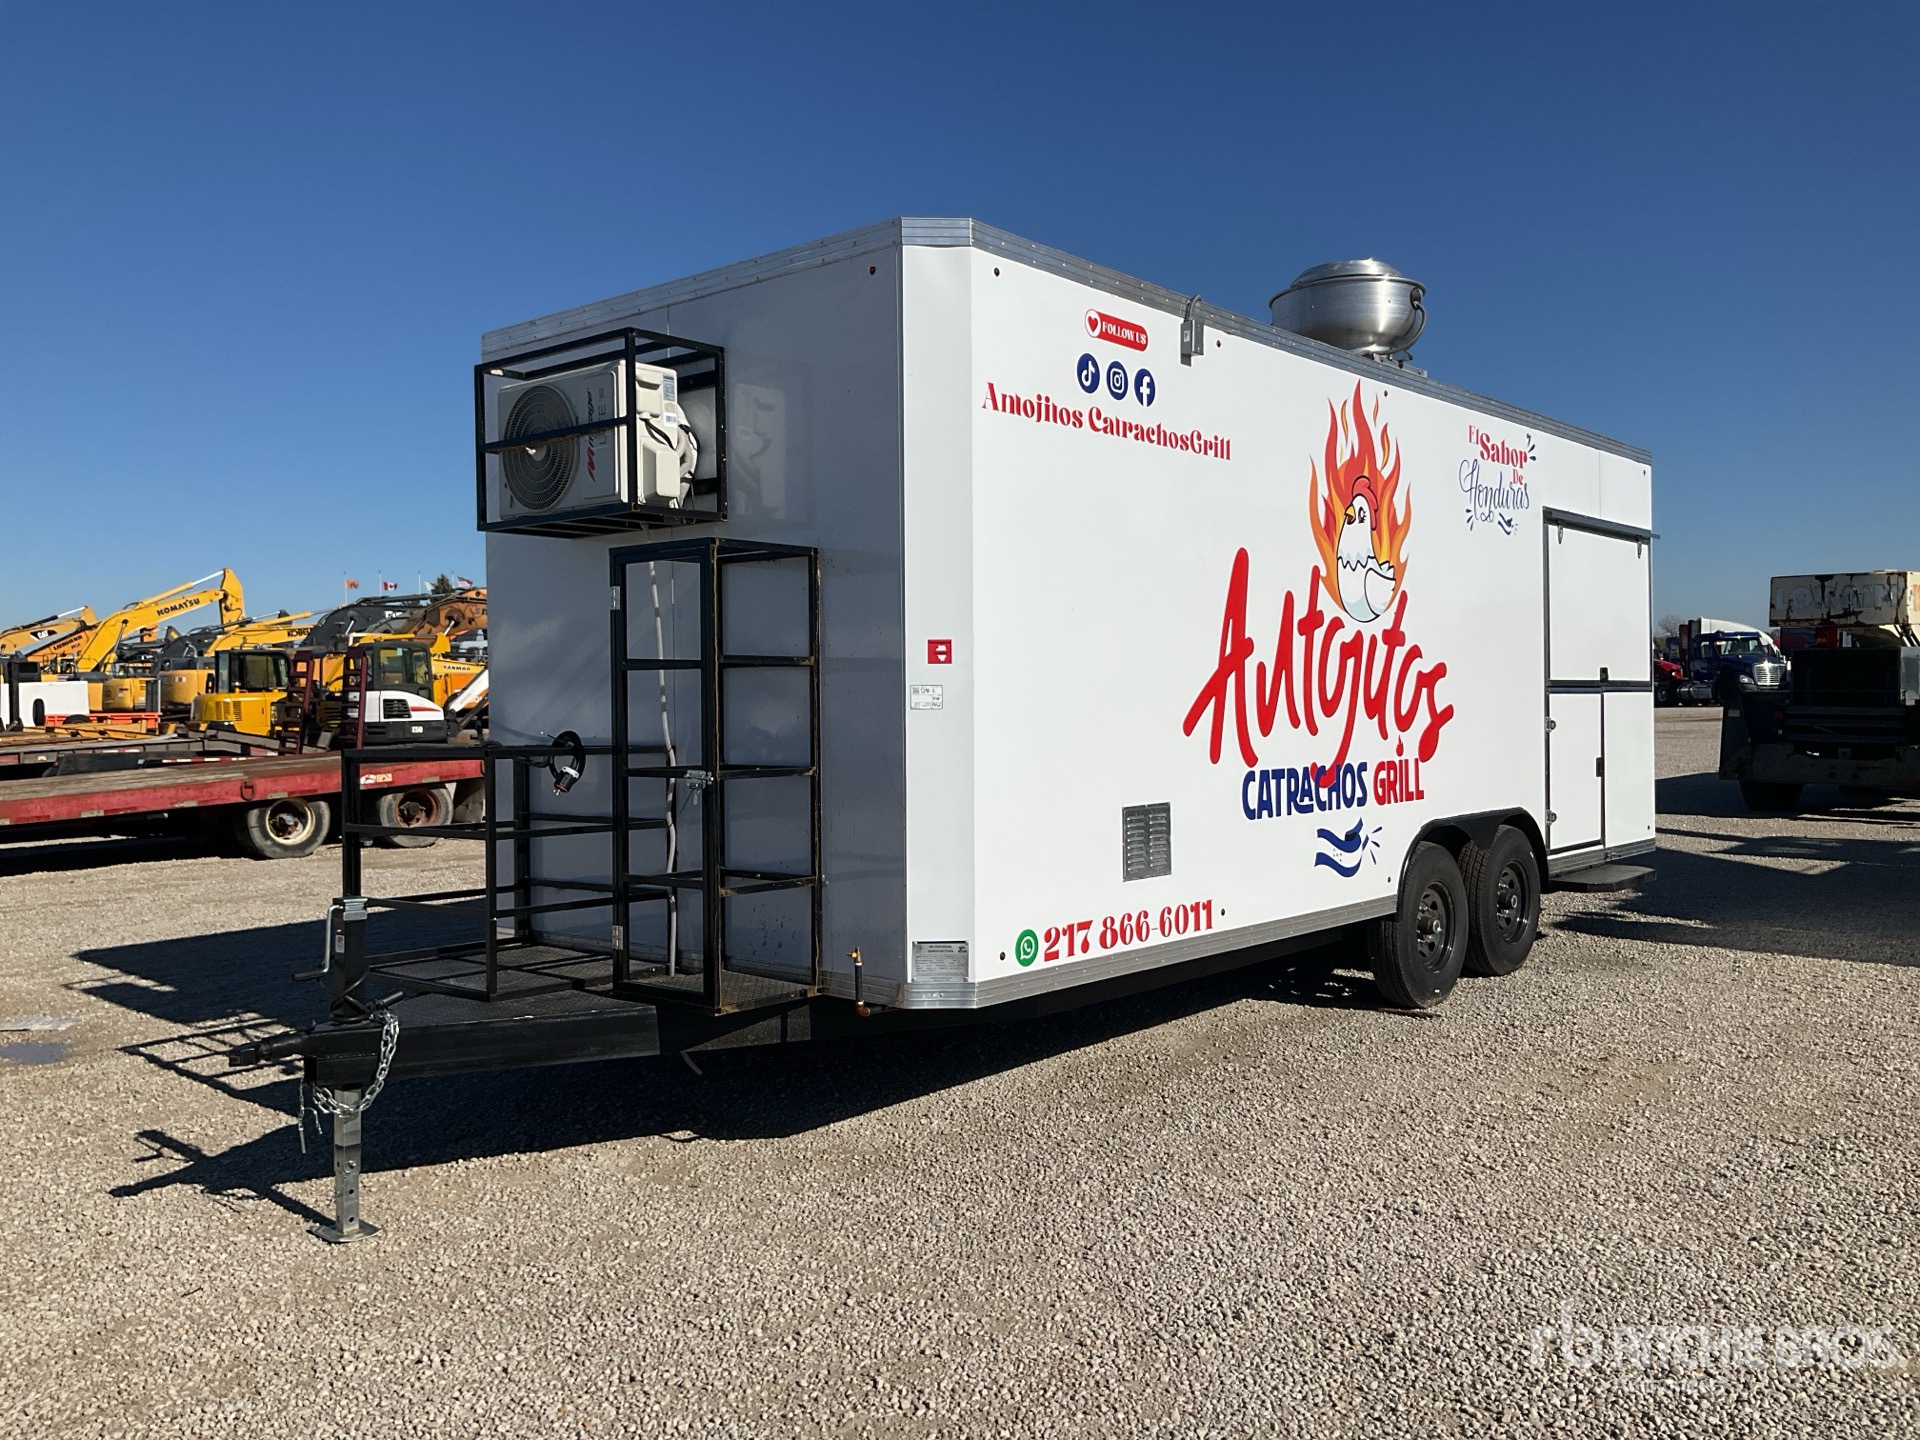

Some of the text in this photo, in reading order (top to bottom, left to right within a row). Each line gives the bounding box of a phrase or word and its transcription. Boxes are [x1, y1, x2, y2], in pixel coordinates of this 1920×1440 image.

[1102, 321, 1147, 345] FOLLOW US
[982, 382, 1231, 461] Antojitos CatrachosGrill
[1468, 425, 1528, 469] El Sabor
[1459, 459, 1529, 523] Honduras
[1513, 469, 1523, 485] De
[157, 598, 200, 616] KOMATSU
[37, 630, 49, 639] CAT
[1242, 757, 1424, 820] CATRACHOS GRILL
[1044, 899, 1213, 962] 217 866-6011
